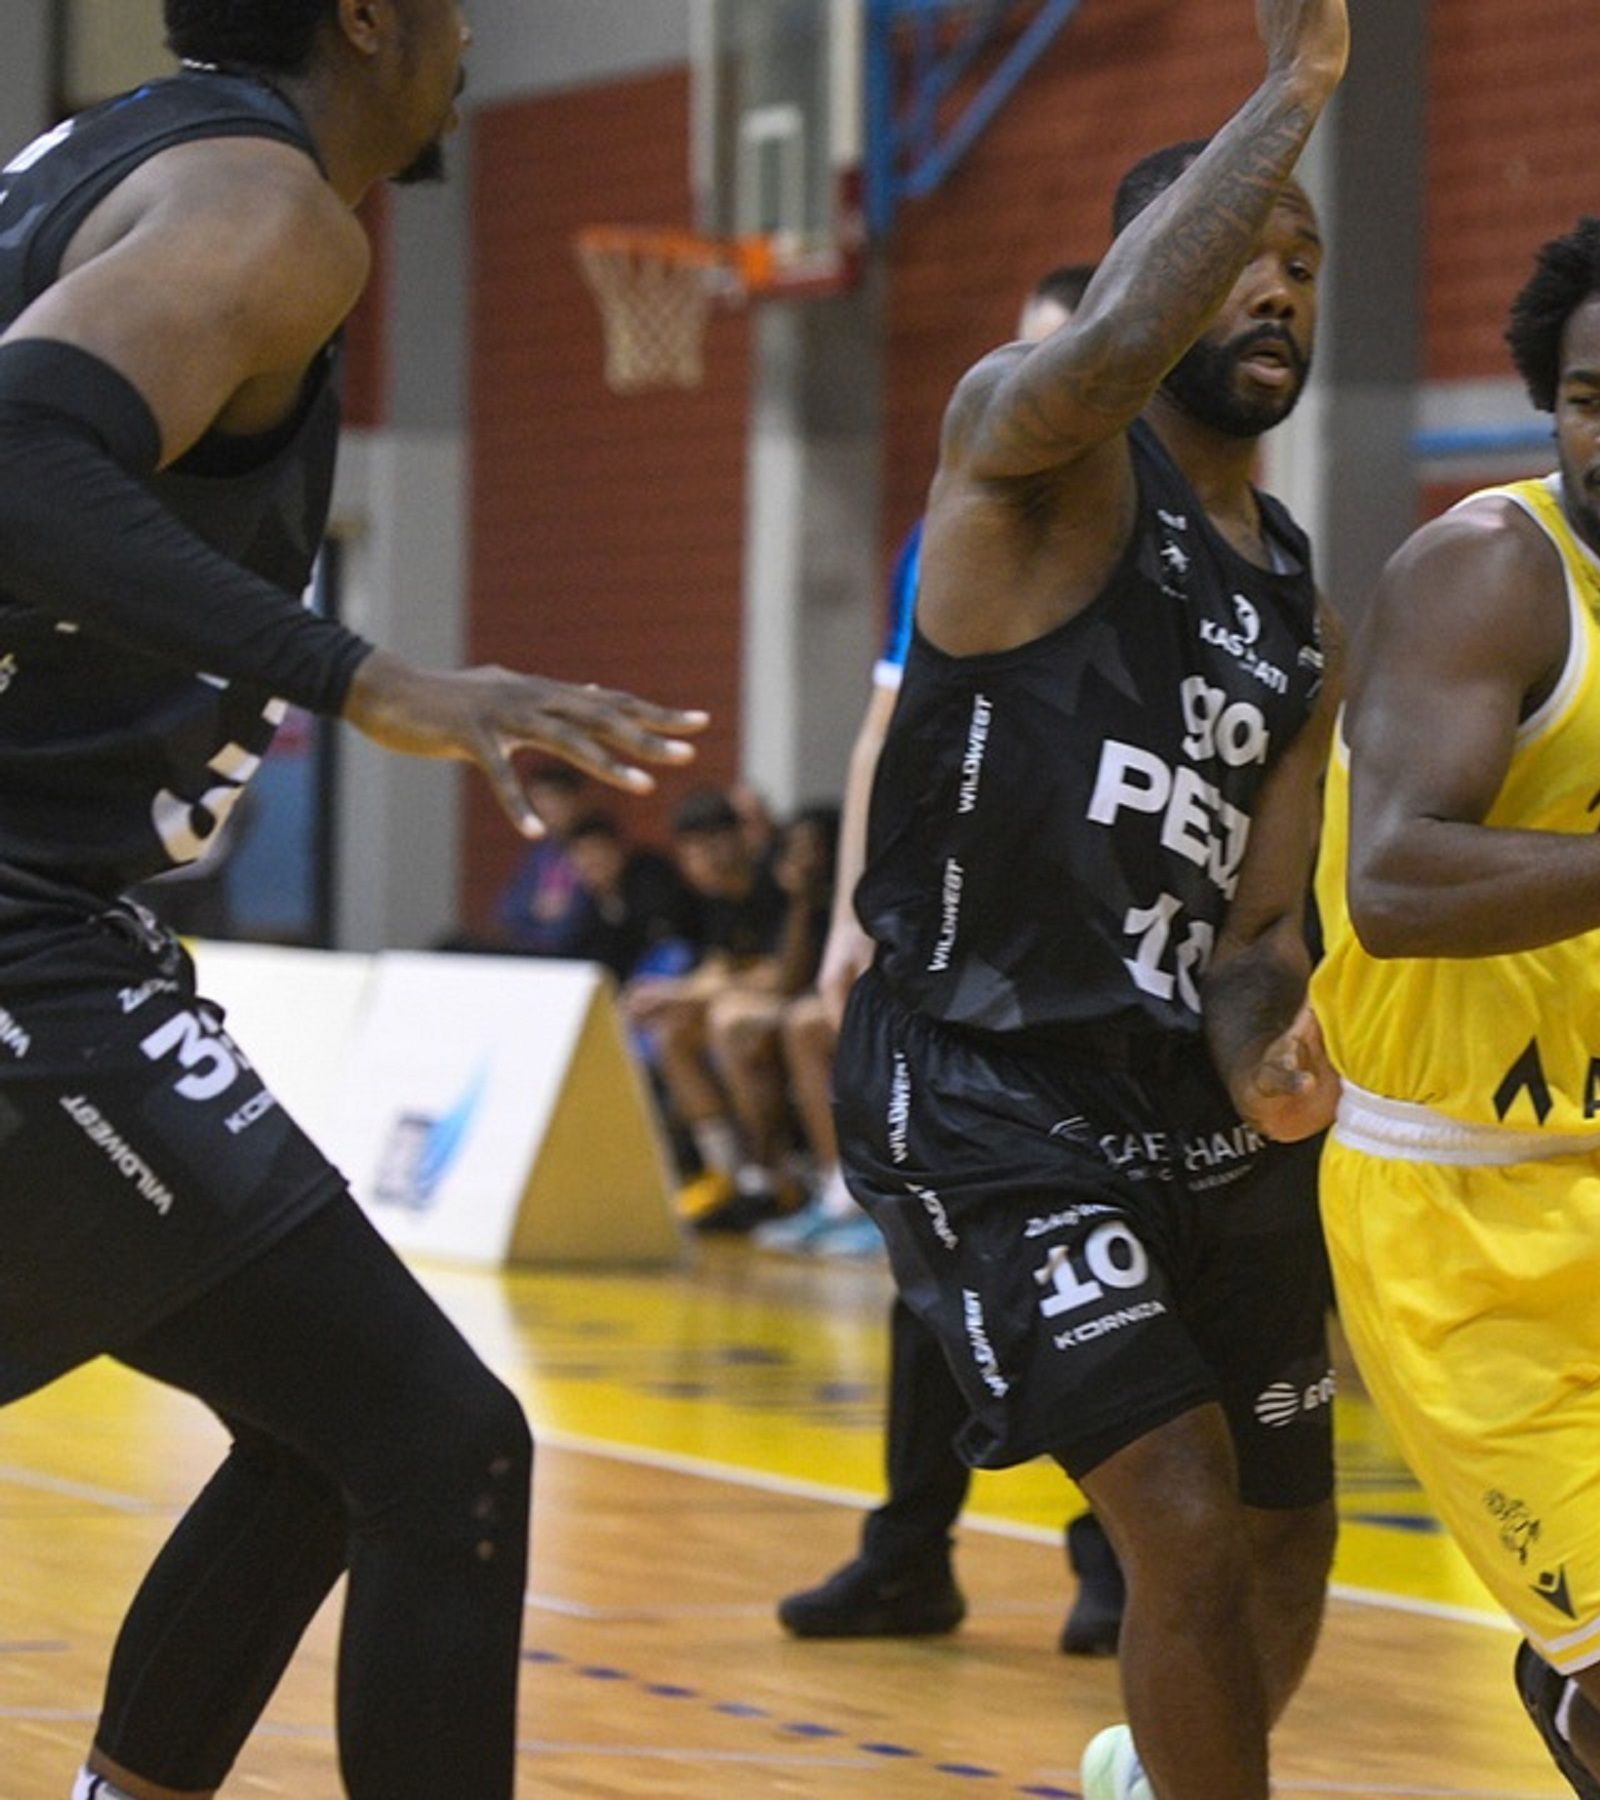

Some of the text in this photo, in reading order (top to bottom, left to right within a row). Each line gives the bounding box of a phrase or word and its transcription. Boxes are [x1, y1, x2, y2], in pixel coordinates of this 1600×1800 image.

[139, 1010, 240, 1101] 3
[59, 1094, 174, 1216] WILDWEST
[1033, 1219, 1149, 1319] 10
